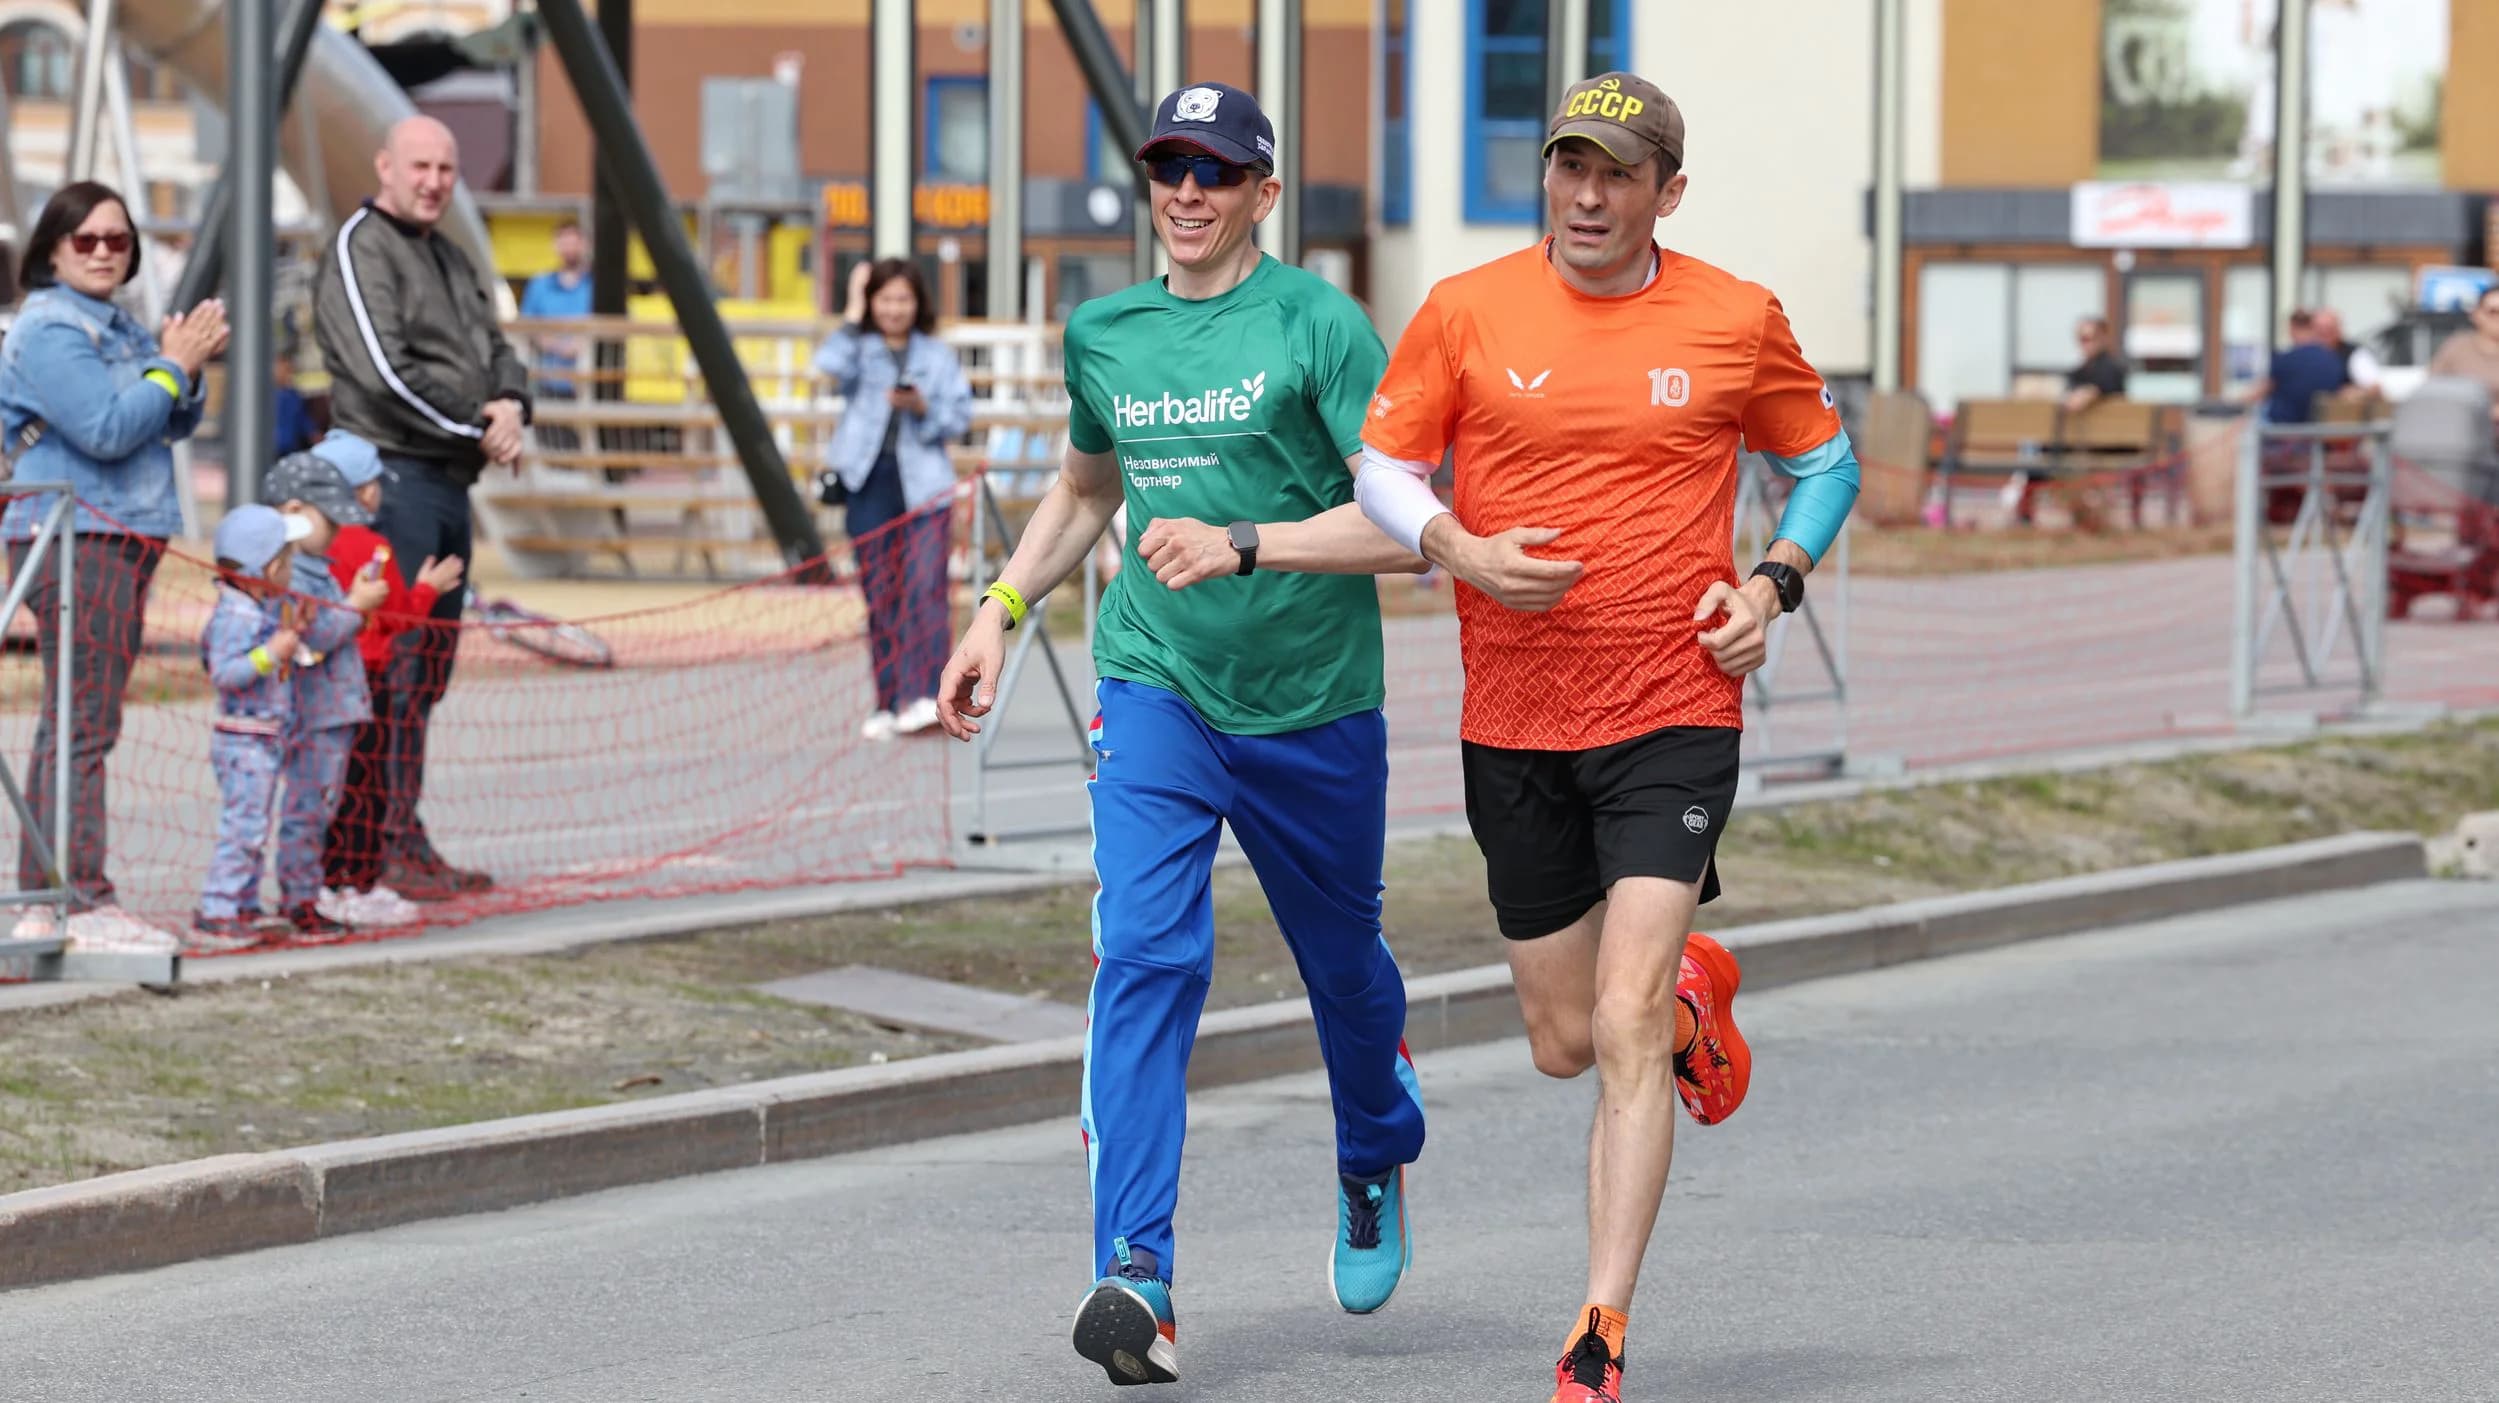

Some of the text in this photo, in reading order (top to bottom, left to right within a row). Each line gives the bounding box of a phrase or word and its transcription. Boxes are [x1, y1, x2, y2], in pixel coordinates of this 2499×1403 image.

[1566, 89, 1644, 122] СССР
[1648, 368, 1690, 407] 10
[1113, 388, 1251, 428] Herbalife
[1123, 452, 1220, 471] Независимый
